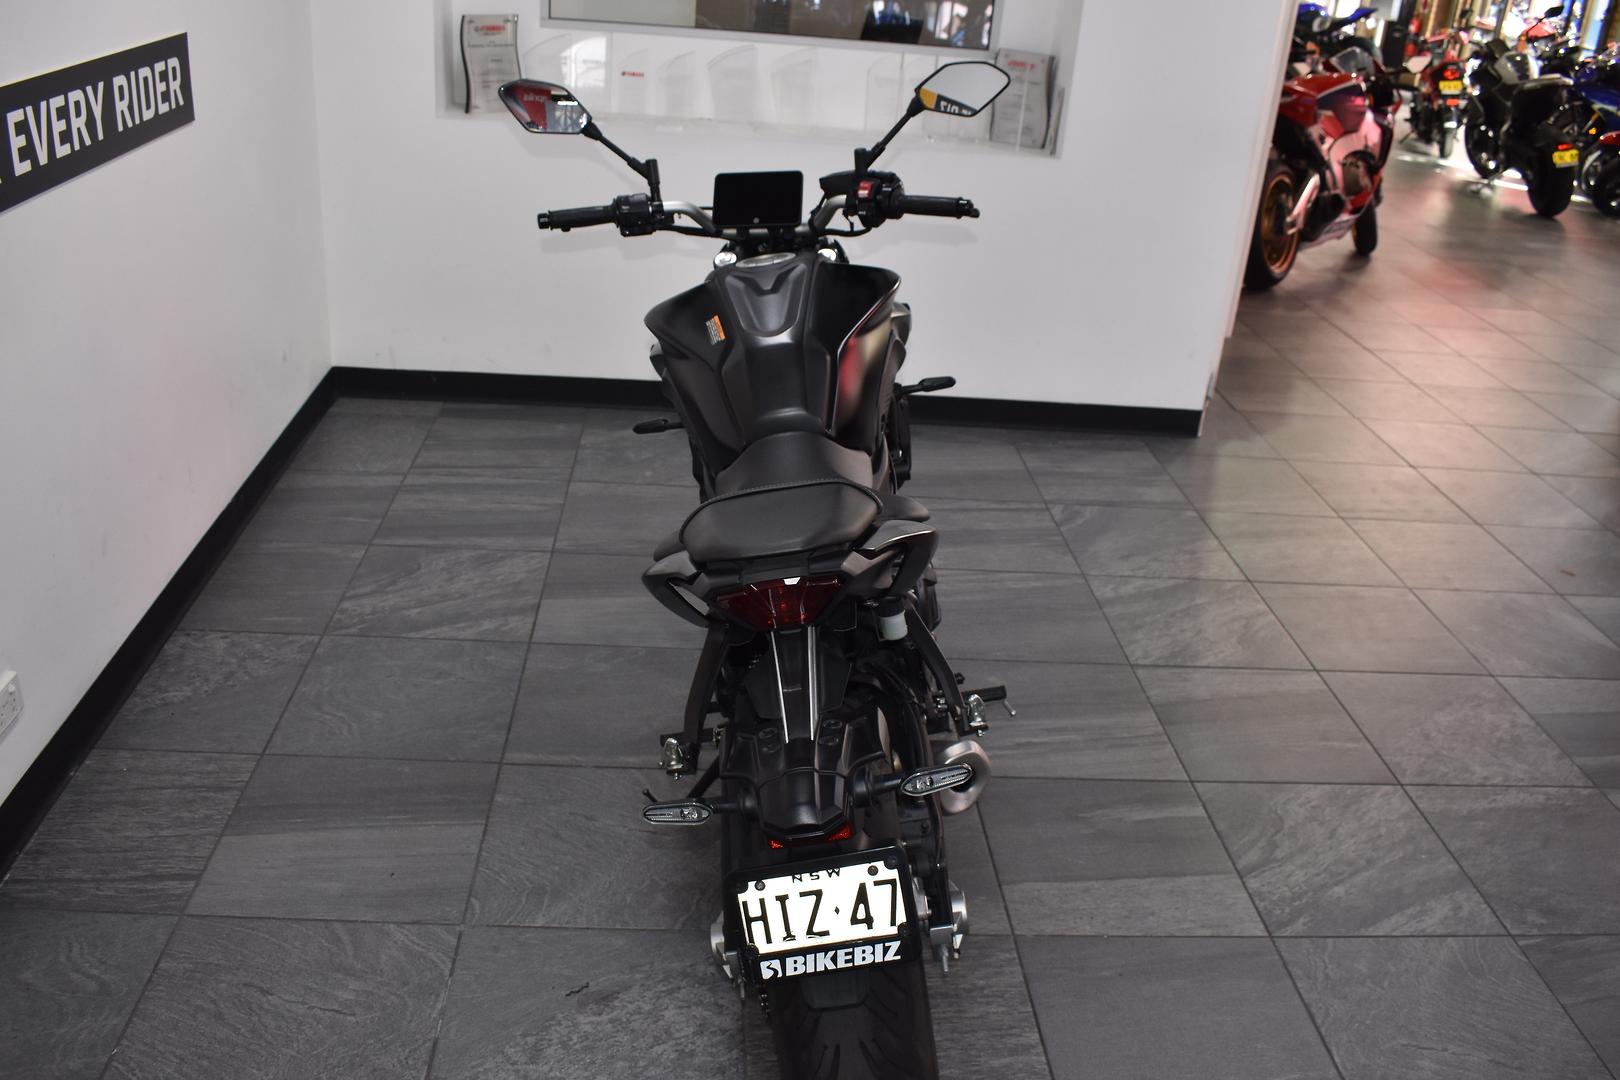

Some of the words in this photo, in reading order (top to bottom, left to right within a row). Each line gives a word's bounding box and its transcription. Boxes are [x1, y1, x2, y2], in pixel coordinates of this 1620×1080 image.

[6, 81, 105, 177] EVERY
[112, 57, 185, 133] RIDER
[792, 868, 841, 884] NSW
[785, 940, 902, 977] BIKEBIZ
